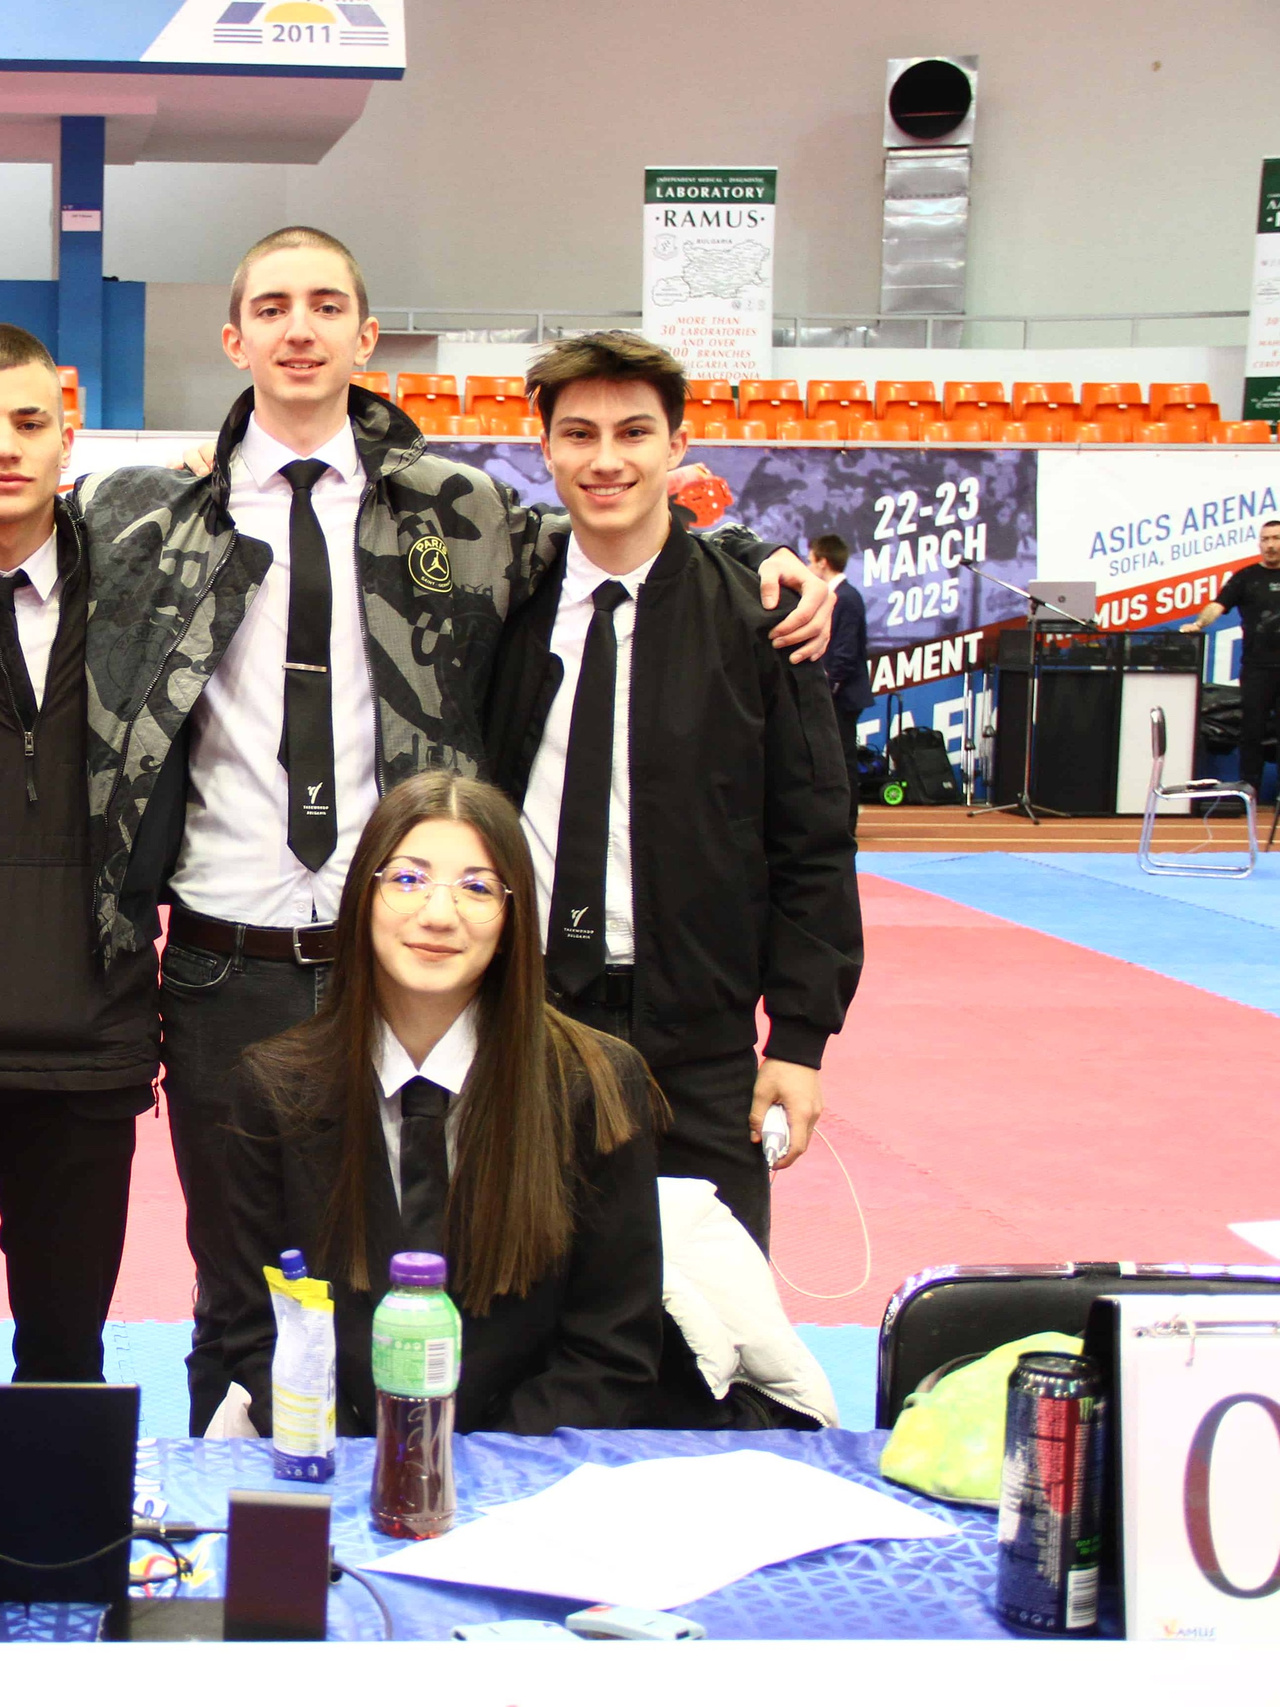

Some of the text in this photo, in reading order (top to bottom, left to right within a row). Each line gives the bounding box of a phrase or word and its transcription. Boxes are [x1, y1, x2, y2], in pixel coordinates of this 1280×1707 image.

[272, 24, 330, 43] 2011
[656, 186, 765, 198] LABORATORY
[677, 317, 740, 325] MORE THAN
[660, 325, 758, 336] 30 LABORATORIES
[682, 338, 704, 346] AND
[696, 350, 752, 358] BRANCHES
[683, 361, 756, 369] ULGARIA AND
[696, 372, 761, 380] MACEDONIA
[873, 477, 979, 540] 22-23
[1090, 486, 1278, 560] ASICS ARENA
[416, 539, 447, 555] PARIS
[863, 523, 987, 588] MARCH
[1109, 525, 1256, 577] SOFIA, BULGARIA
[887, 578, 959, 627] 2025
[1093, 591, 1147, 630] MUS
[867, 631, 984, 693] AMENT
